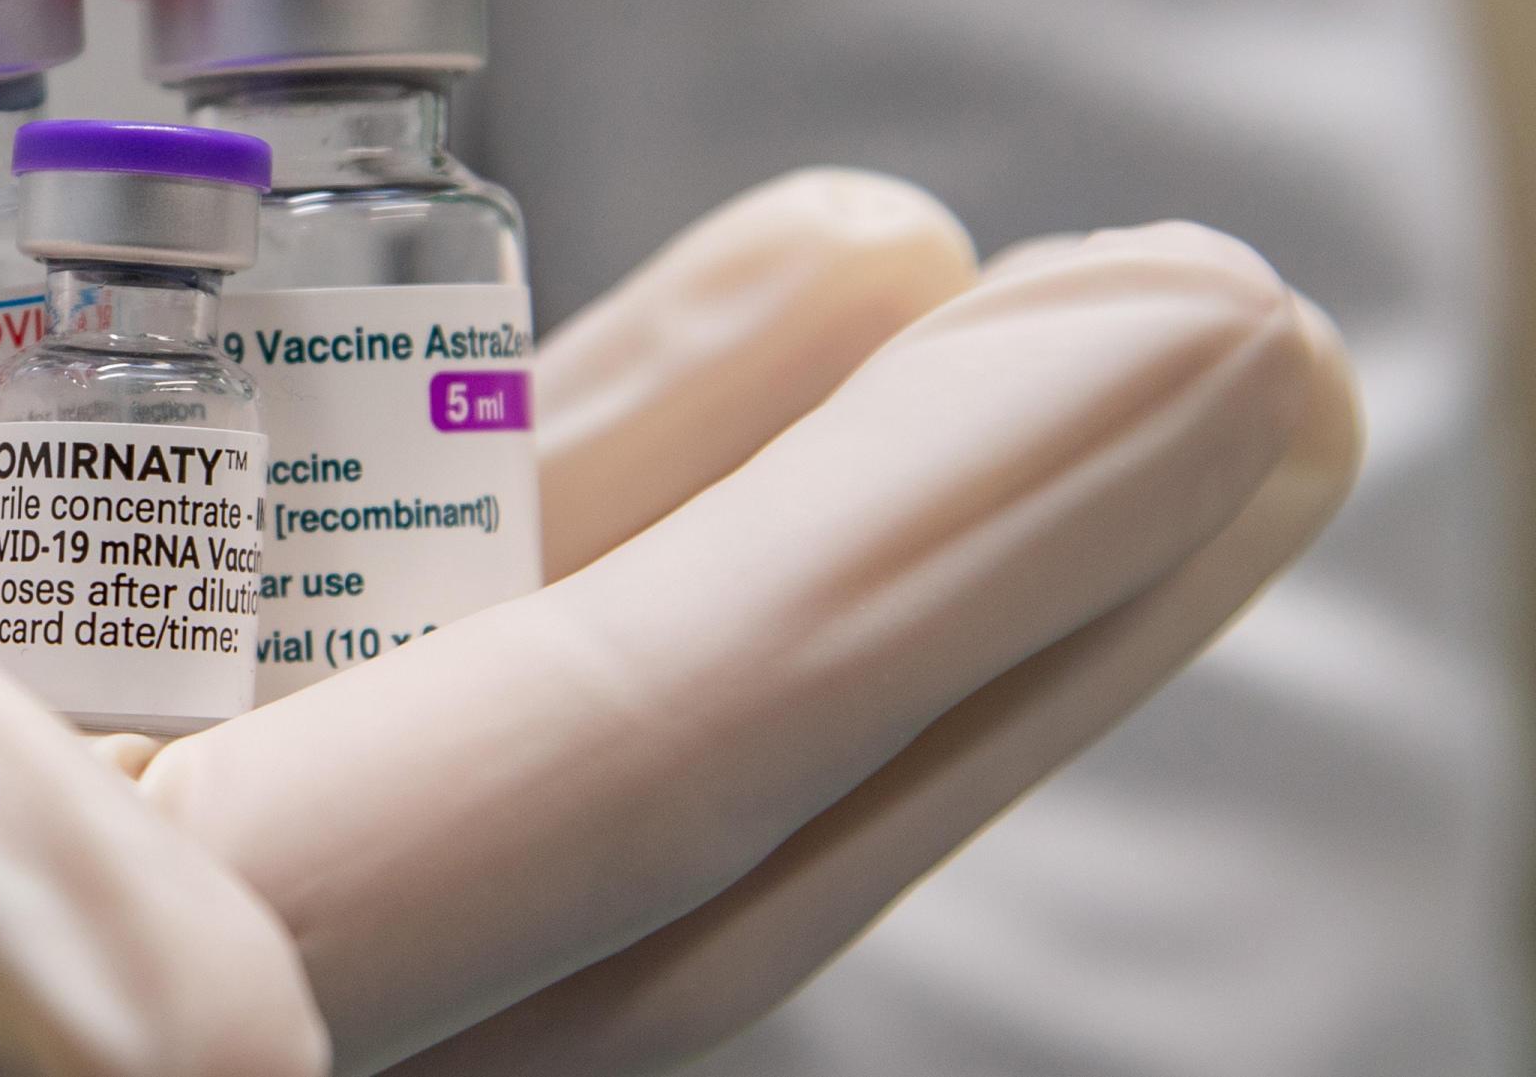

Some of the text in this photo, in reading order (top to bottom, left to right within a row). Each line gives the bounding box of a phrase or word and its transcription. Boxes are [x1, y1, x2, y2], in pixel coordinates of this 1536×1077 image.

[256, 327, 412, 364] Vaccine
[424, 324, 531, 360] AstraZe
[446, 382, 505, 422] 5 ml
[266, 453, 362, 485] ccine
[51, 494, 241, 529] concentrate
[275, 495, 499, 540] [recombinant])
[100, 533, 200, 569] mRNA
[88, 572, 178, 609] after
[303, 572, 365, 598] use
[75, 611, 239, 654] date/time:
[325, 628, 381, 670] (10
